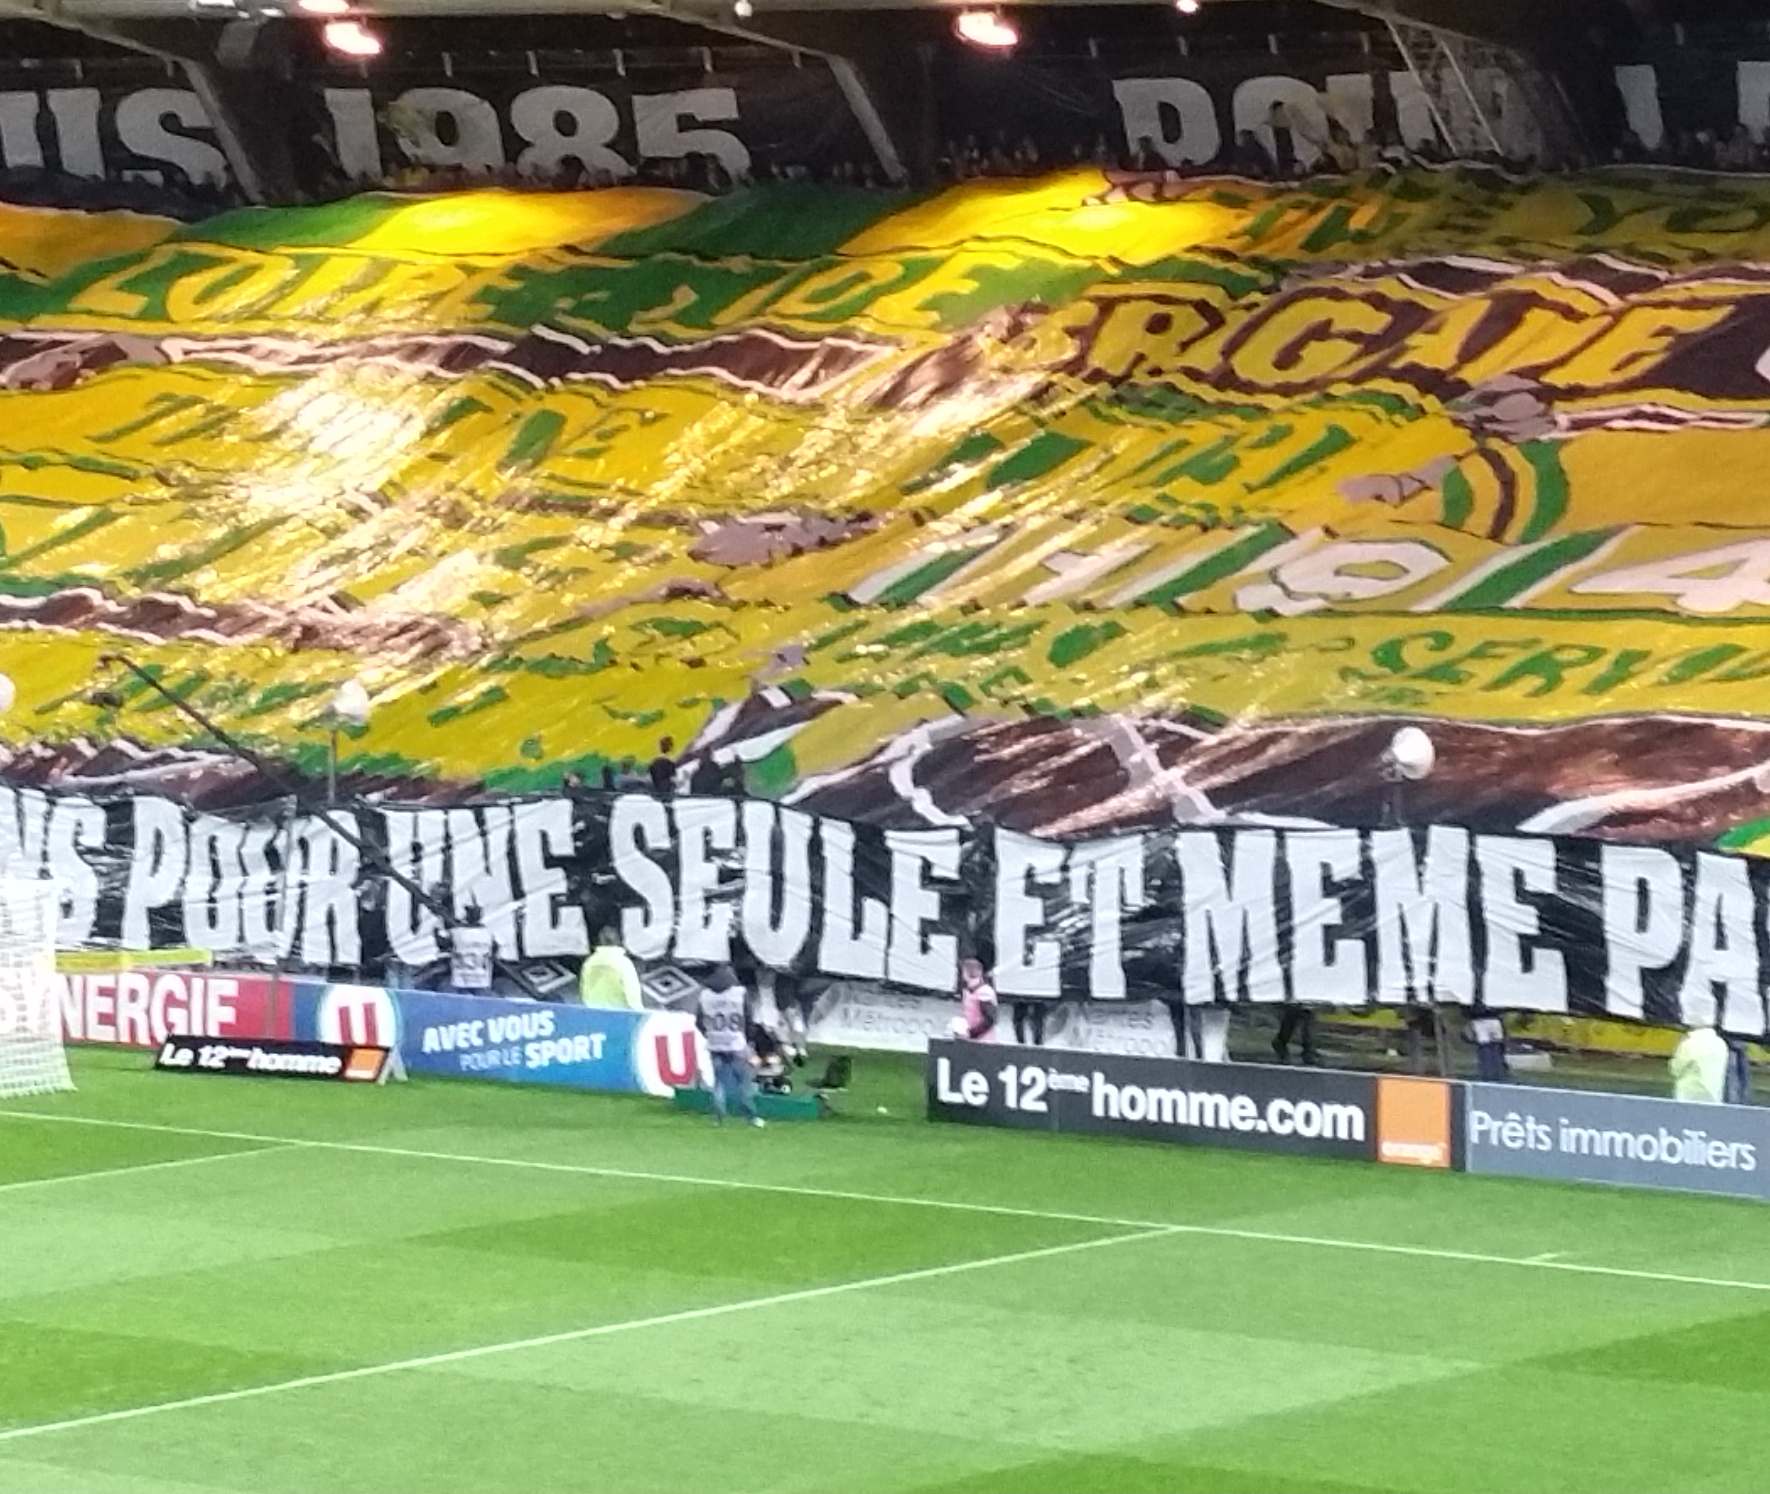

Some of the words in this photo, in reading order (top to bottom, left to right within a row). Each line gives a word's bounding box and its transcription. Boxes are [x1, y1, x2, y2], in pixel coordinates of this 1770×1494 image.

[324, 86, 752, 186] 1985
[123, 795, 361, 965] POUR
[385, 798, 589, 966] UNE
[610, 793, 961, 992] SEULE
[994, 826, 1145, 1000] ET
[1175, 824, 1568, 1011] MEME
[159, 1043, 194, 1067] Le
[246, 1046, 342, 1075] homme
[422, 1018, 484, 1055] AVEC
[486, 1009, 556, 1044] VOUS
[460, 1046, 504, 1072] POUR
[502, 1045, 523, 1067] LE
[524, 1032, 608, 1070] SPORT
[654, 1029, 697, 1087] U
[935, 1057, 990, 1106] Le
[1091, 1069, 1366, 1143] homme.com
[1469, 1109, 1553, 1152] Prêts
[1558, 1116, 1757, 1172] immobiliers
